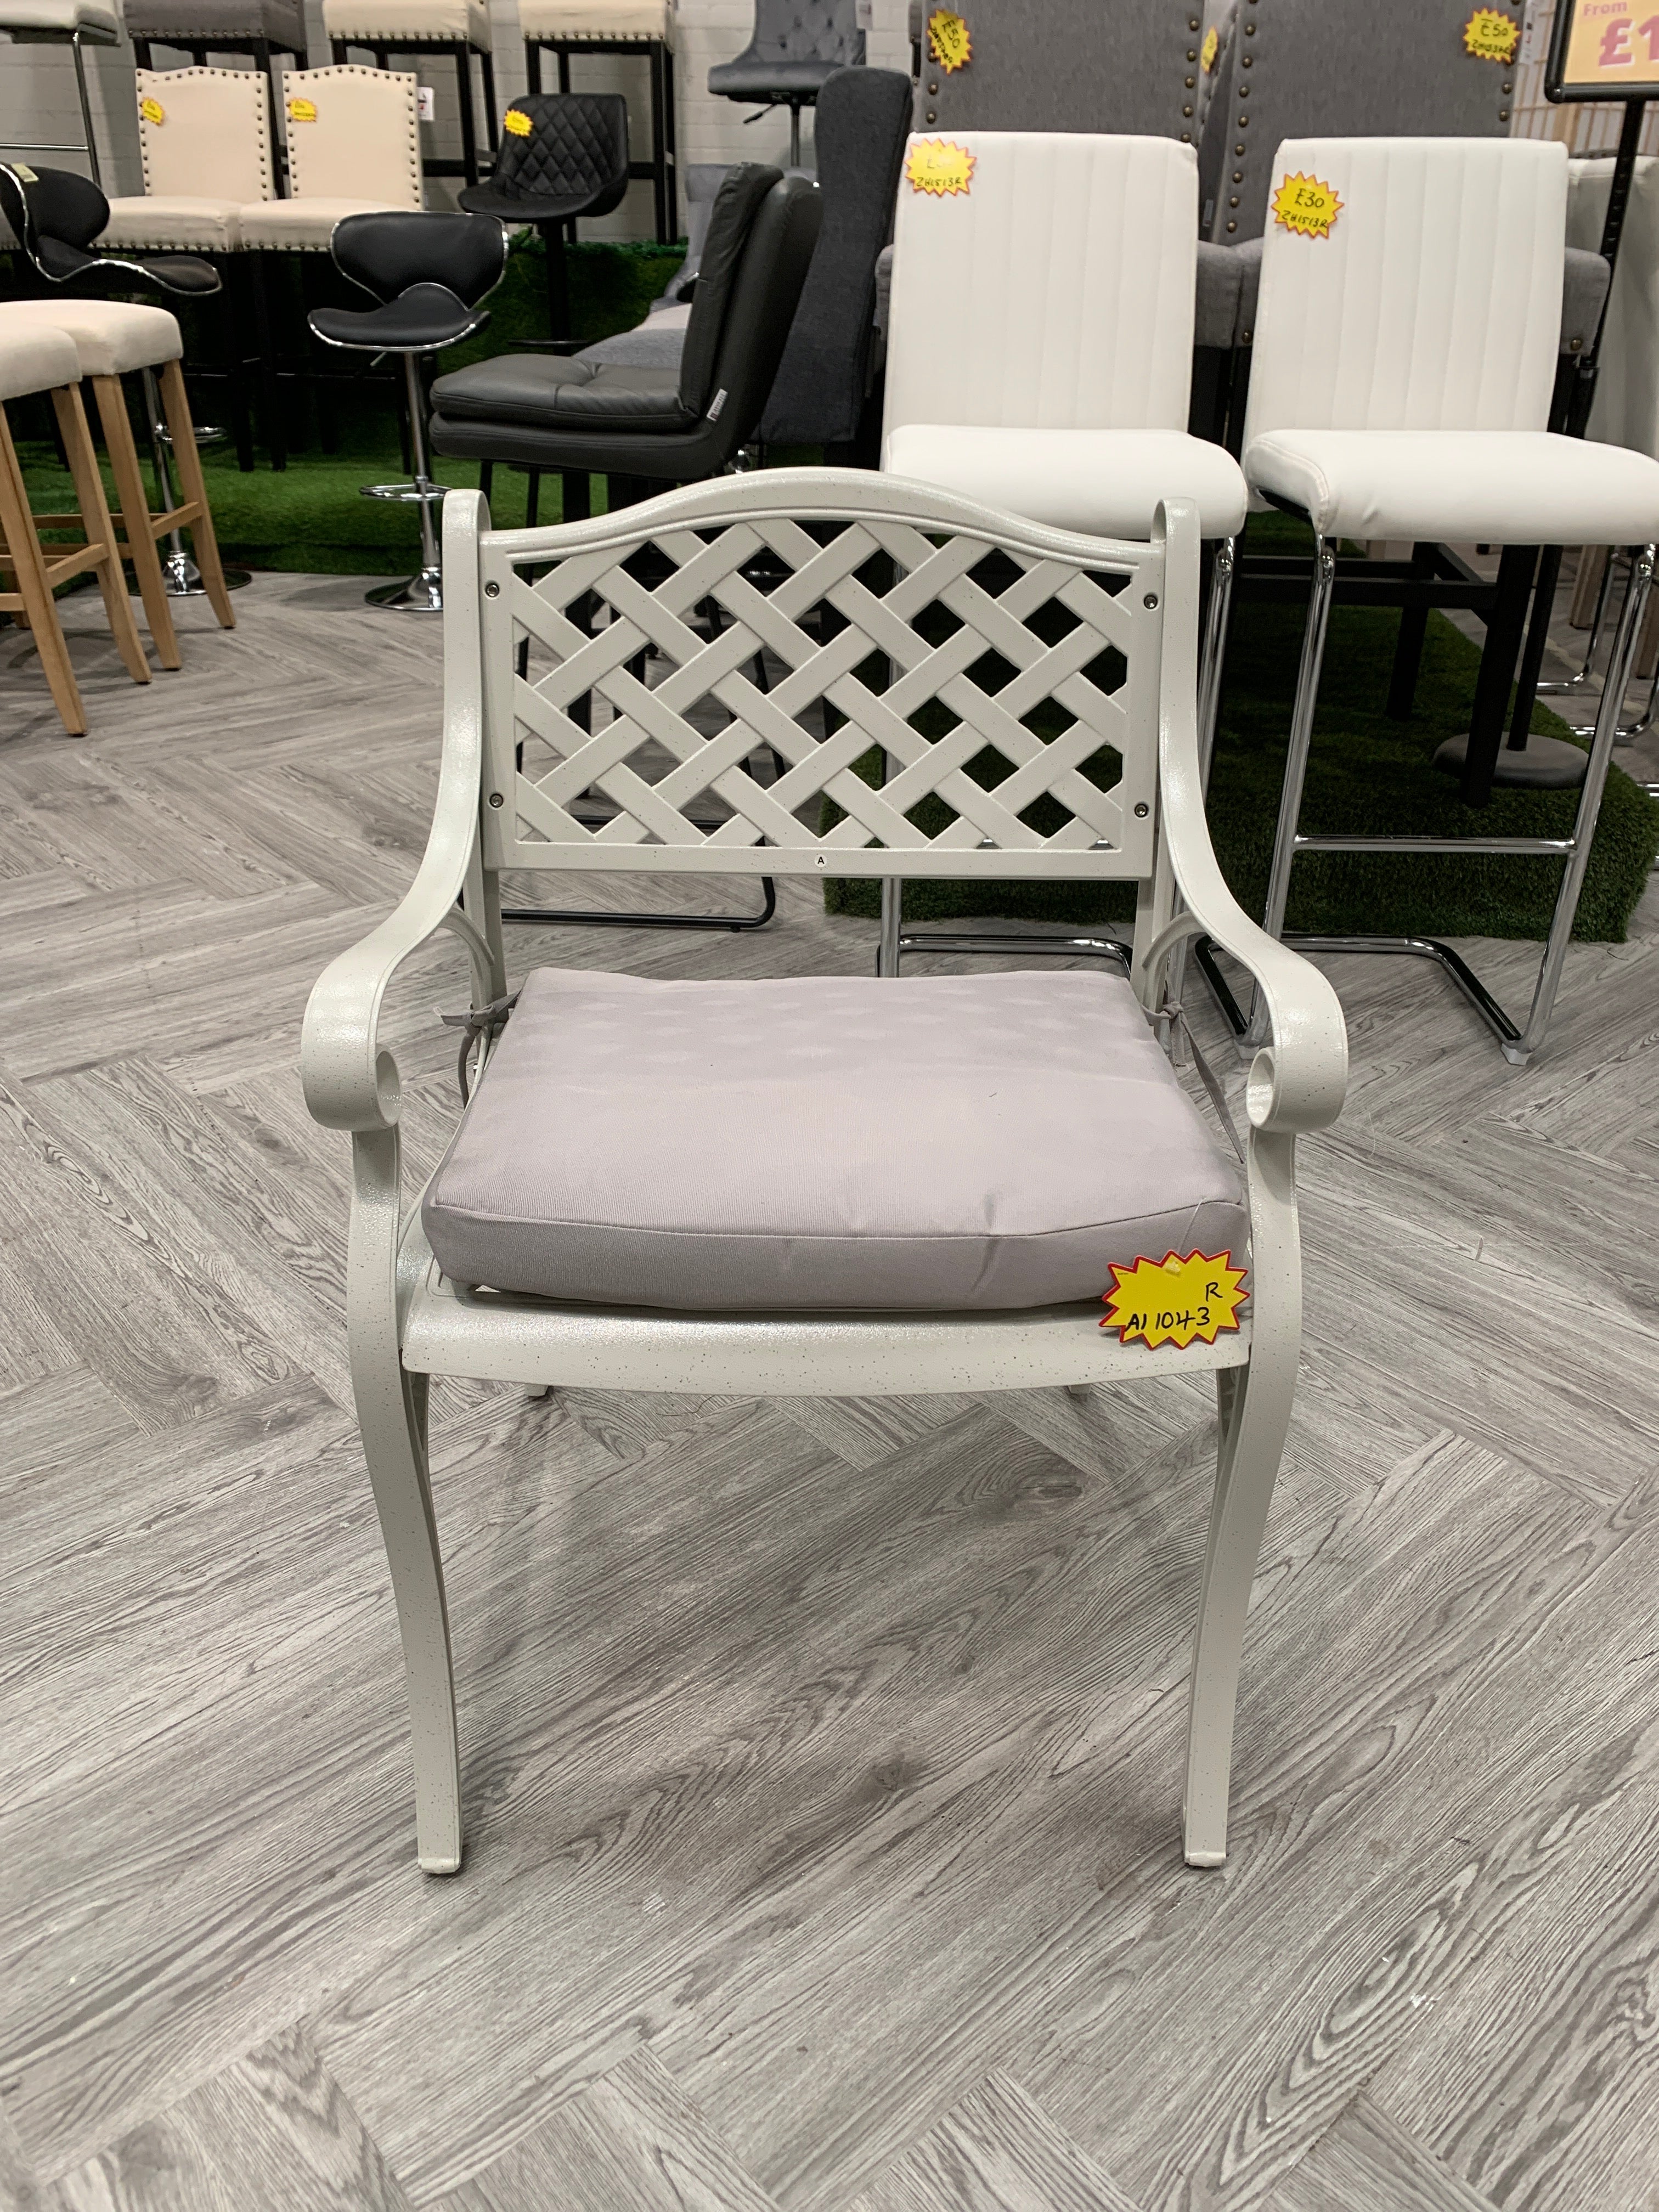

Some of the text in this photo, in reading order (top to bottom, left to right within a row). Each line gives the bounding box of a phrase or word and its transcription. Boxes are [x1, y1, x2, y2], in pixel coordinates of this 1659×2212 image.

[1583, 2, 1627, 16] From
[1295, 188, 1325, 208] £30
[817, 856, 825, 865] A
[1205, 1282, 1223, 1302] R
